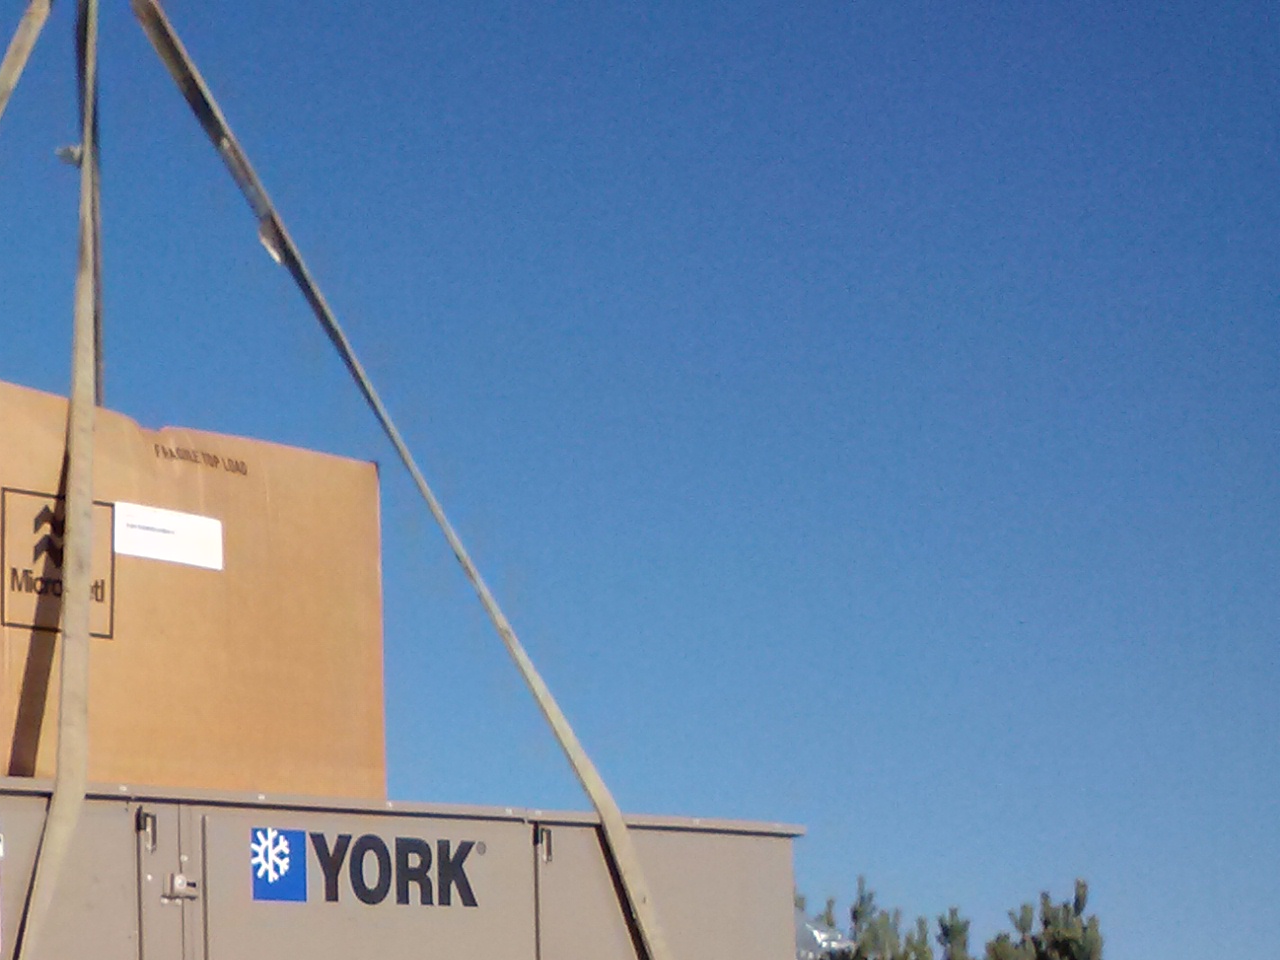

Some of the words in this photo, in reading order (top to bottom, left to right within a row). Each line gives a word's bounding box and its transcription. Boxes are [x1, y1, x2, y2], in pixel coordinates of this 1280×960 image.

[201, 450, 220, 469] TOP
[221, 457, 248, 476] LOAD
[10, 567, 105, 602] Microtl
[309, 831, 478, 907] YORK
